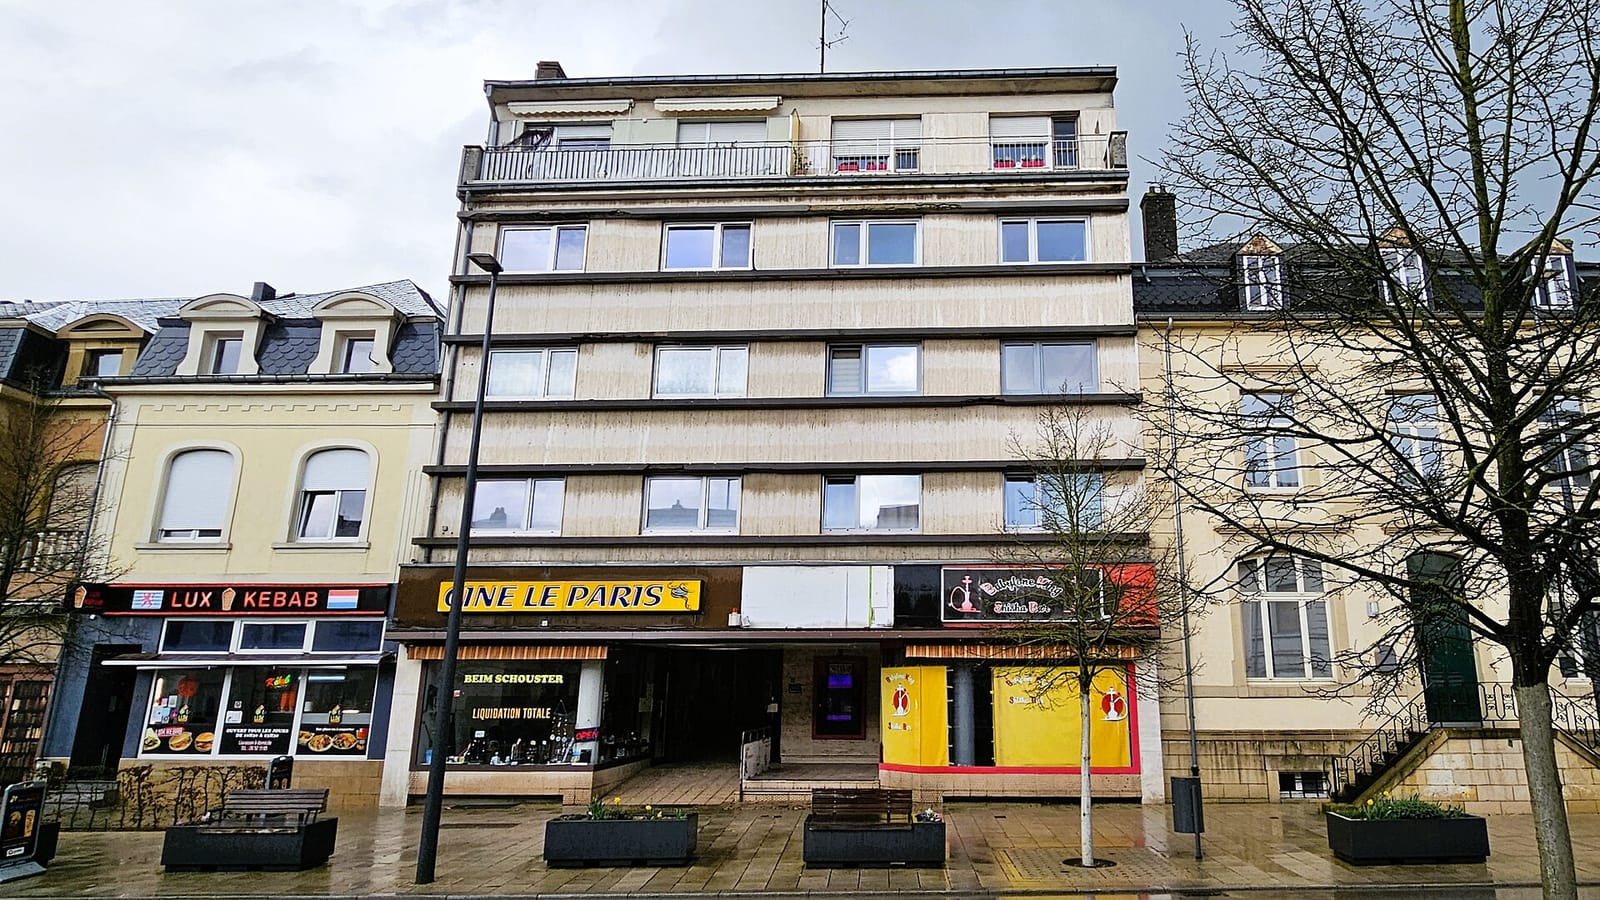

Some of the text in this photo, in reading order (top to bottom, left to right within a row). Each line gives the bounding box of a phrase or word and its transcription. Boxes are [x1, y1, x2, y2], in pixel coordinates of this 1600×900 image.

[171, 591, 318, 608] LUX KEBAB
[523, 585, 561, 608] LE
[565, 584, 664, 608] PARIS
[463, 674, 564, 684] BEIM SCHOUSTER
[472, 707, 552, 720] LIQUIDATION TOTALE
